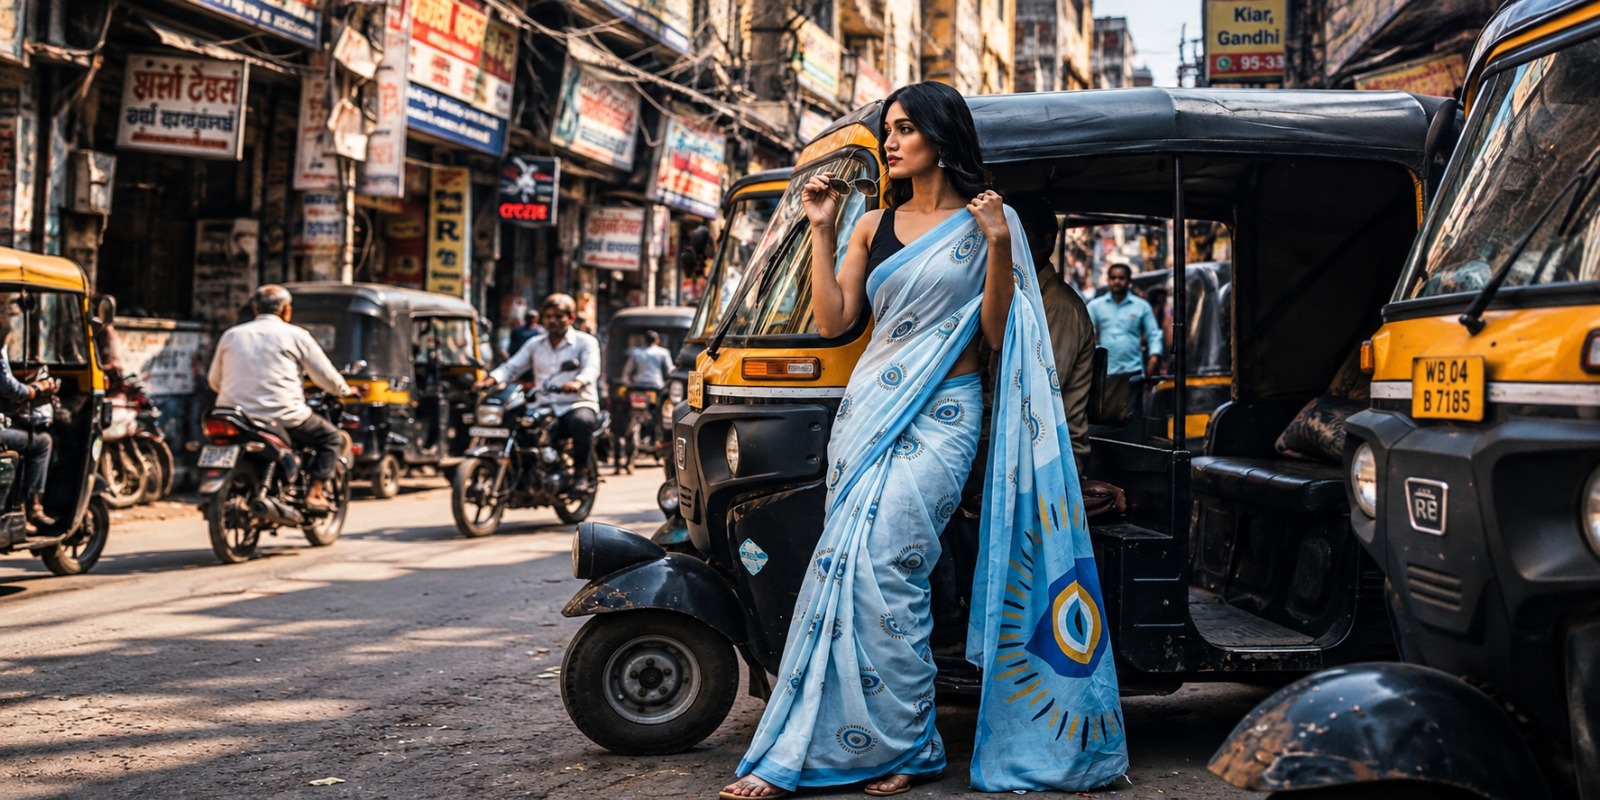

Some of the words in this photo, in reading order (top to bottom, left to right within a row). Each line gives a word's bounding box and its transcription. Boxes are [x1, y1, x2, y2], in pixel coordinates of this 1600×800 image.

[1234, 7, 1273, 24] Kiar,
[1217, 28, 1279, 46] Gandhi
[1426, 360, 1446, 383] WB
[1449, 360, 1468, 383] 04
[1423, 390, 1432, 412] B
[1436, 390, 1470, 413] 7185
